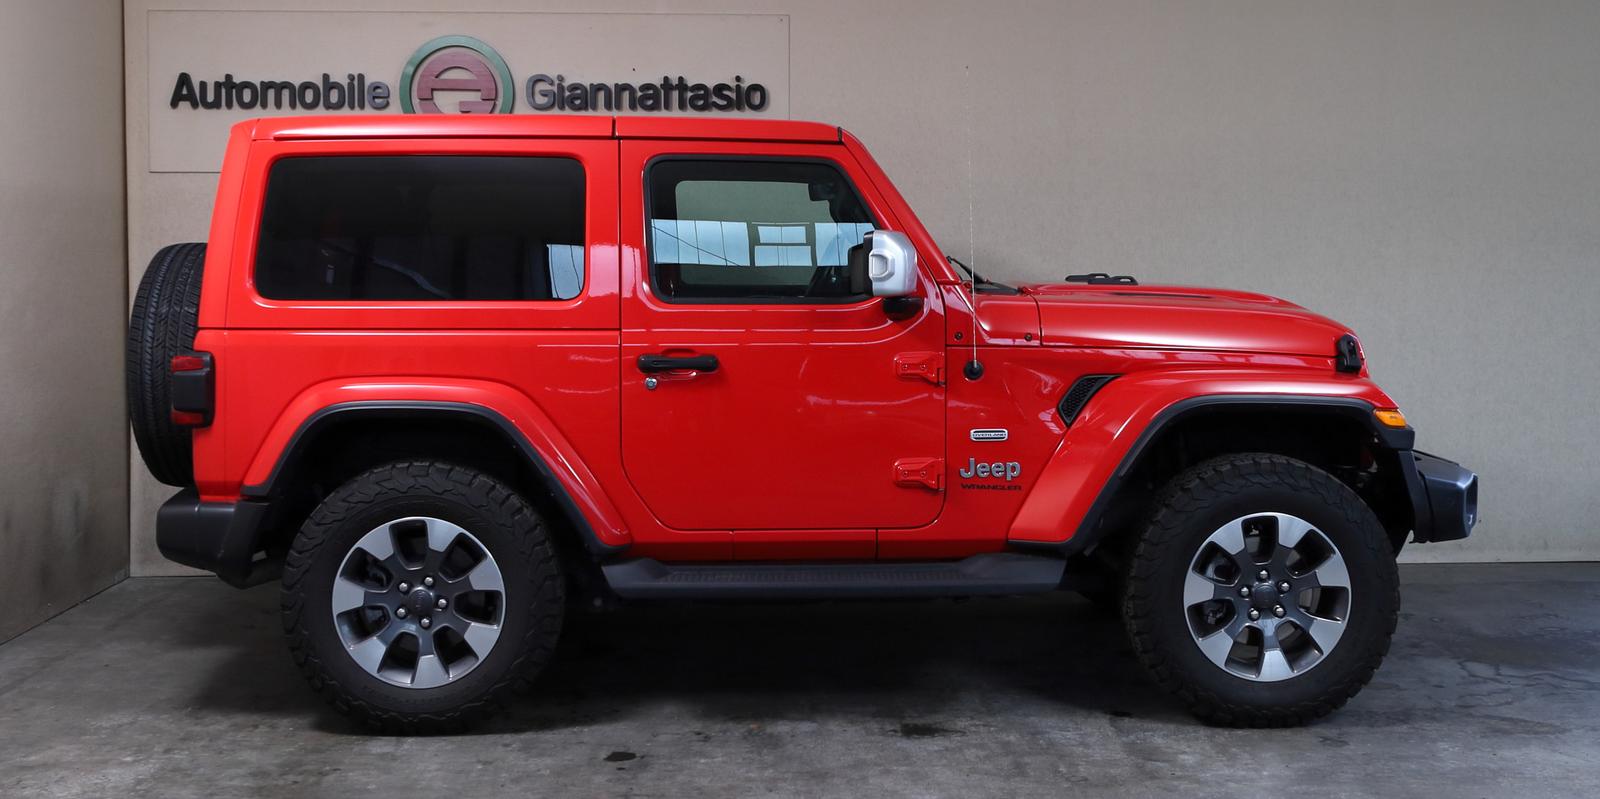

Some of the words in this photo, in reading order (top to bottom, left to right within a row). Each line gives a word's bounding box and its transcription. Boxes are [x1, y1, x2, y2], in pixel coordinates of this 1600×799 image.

[170, 72, 390, 110] Automobile
[525, 74, 767, 112] Giannattasio
[959, 457, 1021, 481] Jeep
